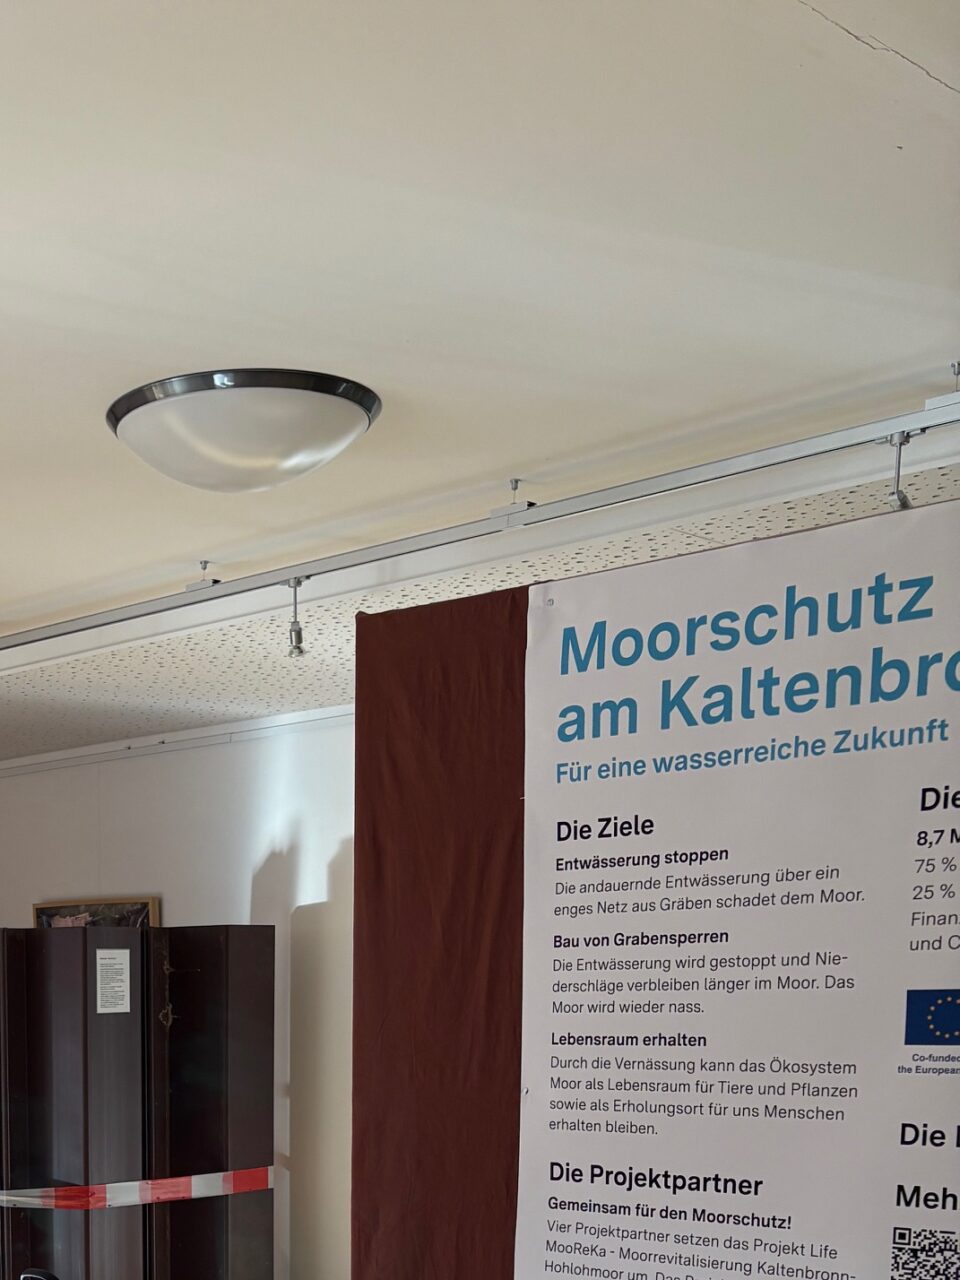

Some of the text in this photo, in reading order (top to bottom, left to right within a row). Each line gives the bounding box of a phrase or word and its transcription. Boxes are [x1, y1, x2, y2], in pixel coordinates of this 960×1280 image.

[560, 572, 934, 675] Moorschutz
[557, 697, 637, 742] am
[557, 718, 949, 784] Für eine wasserreiche Zukunft
[921, 785, 960, 811] Die
[557, 814, 654, 842] Die Ziele
[917, 829, 945, 849] 8,7
[556, 849, 728, 871] Entwässerung stoppen
[915, 857, 957, 874] 75 %
[555, 865, 839, 895] Die andauernde Entwässerung über ein
[912, 883, 956, 900] 25 %
[554, 889, 865, 919] enges Netz aus Gräben schadet dem Moor.
[911, 912, 960, 927] Finan
[554, 932, 729, 948] Bau von Grabensperren
[910, 936, 942, 951] und
[553, 951, 848, 973] Die Entwässerung wird gestoppt und Nie-
[552, 975, 855, 995] derschläge verbleiben länger im Moor. Das
[552, 1000, 704, 1014] Moor wird wieder nass.
[552, 1032, 707, 1047] Lebensraum erhalten
[550, 1056, 856, 1077] Durch die Vernässung kann das Ökosystem
[898, 1065, 913, 1074] the
[550, 1077, 858, 1098] Moor als Lebensraum für Tiere und Pflanzen
[550, 1098, 844, 1121] sowie als Erholungsort für uns Menschen
[549, 1118, 658, 1135] erhalten bleiben.
[900, 1123, 946, 1147] Die
[550, 1162, 763, 1196] Die Projektpartner
[548, 1196, 791, 1230] Gemeinsam für den Moorschutz!
[547, 1219, 838, 1260] Vier Projektpartner setzen das Projekt Life
[546, 1240, 606, 1257] MooReKa
[619, 1246, 752, 1276] Moorrevitalisierung
[545, 1260, 624, 1280] Hohlohmoor
